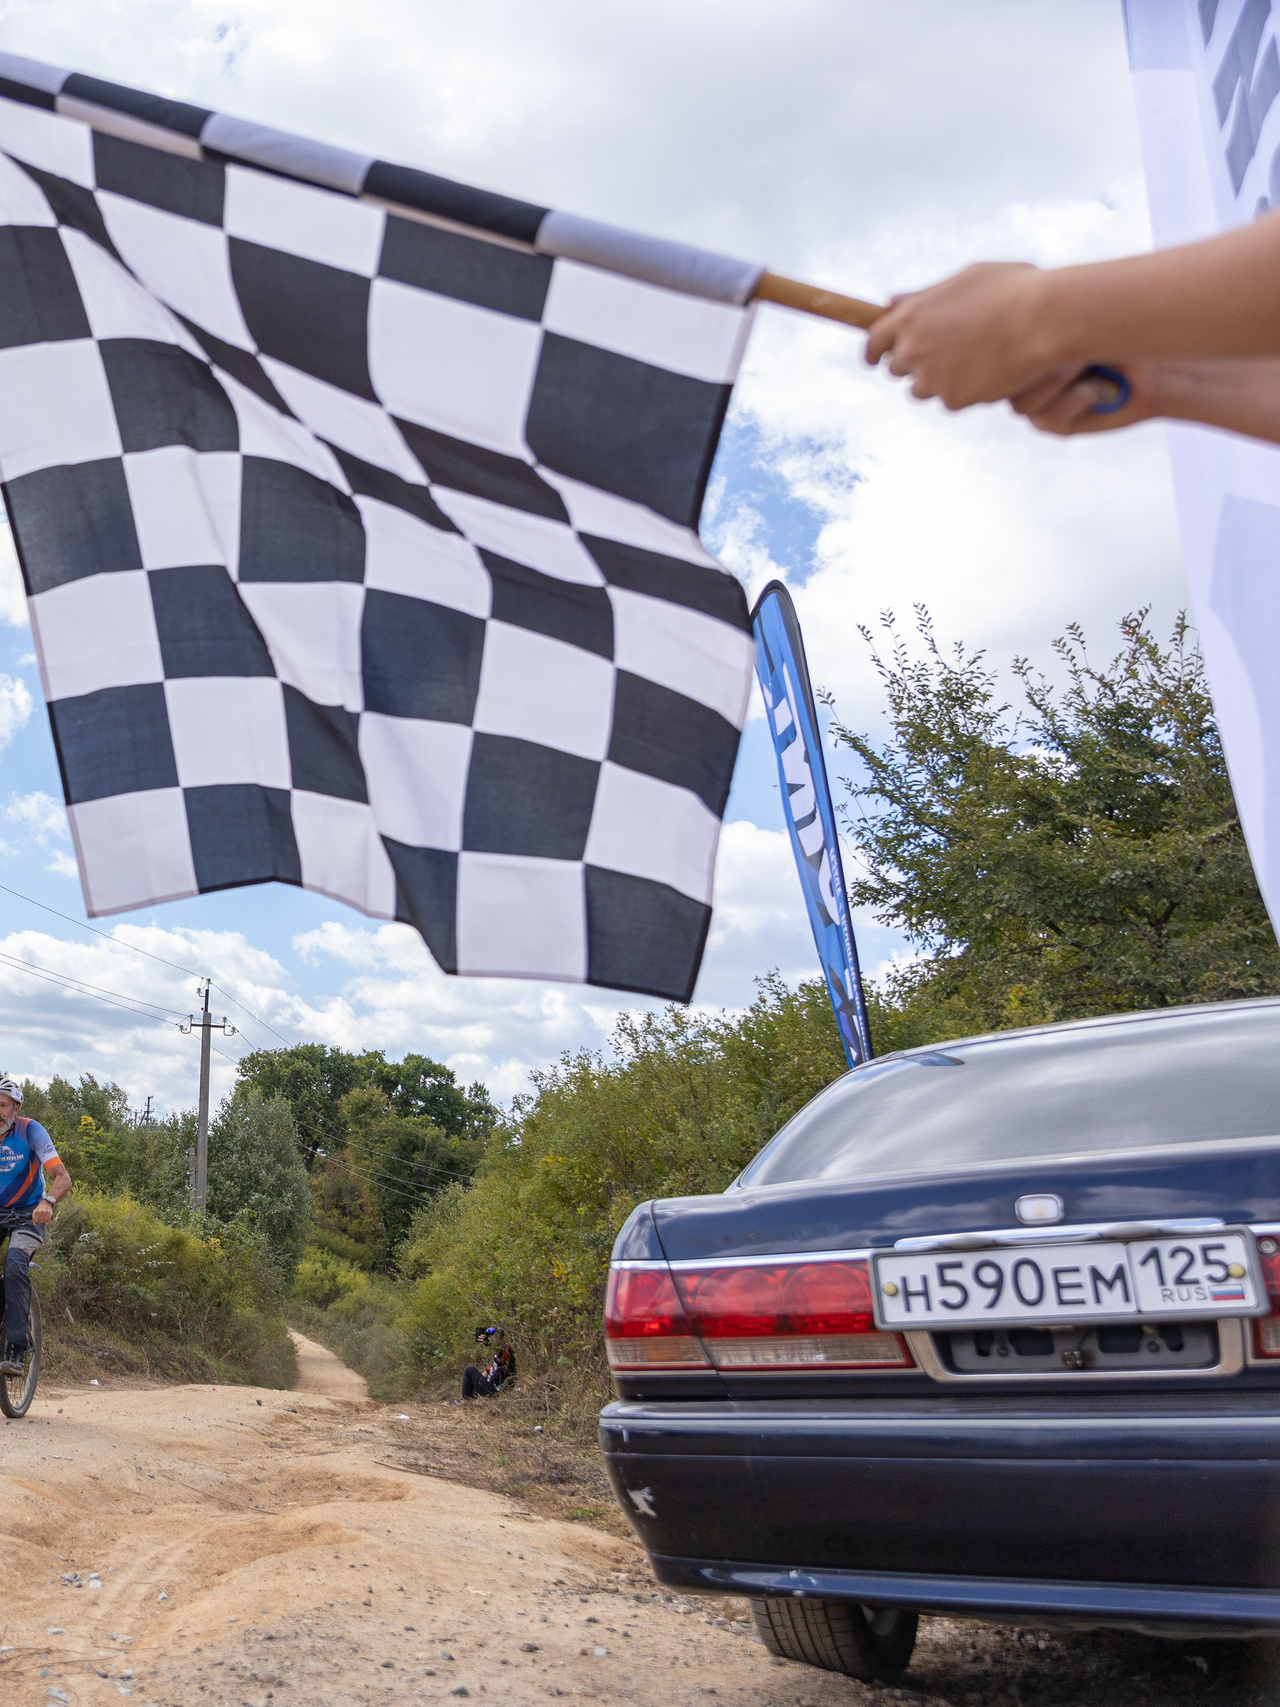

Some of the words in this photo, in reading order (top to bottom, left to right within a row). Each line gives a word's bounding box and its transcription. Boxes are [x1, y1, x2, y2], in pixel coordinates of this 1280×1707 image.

[900, 1256, 1132, 1313] Н590ЕМ
[1137, 1242, 1231, 1288] 125
[1160, 1286, 1209, 1304] RUS
